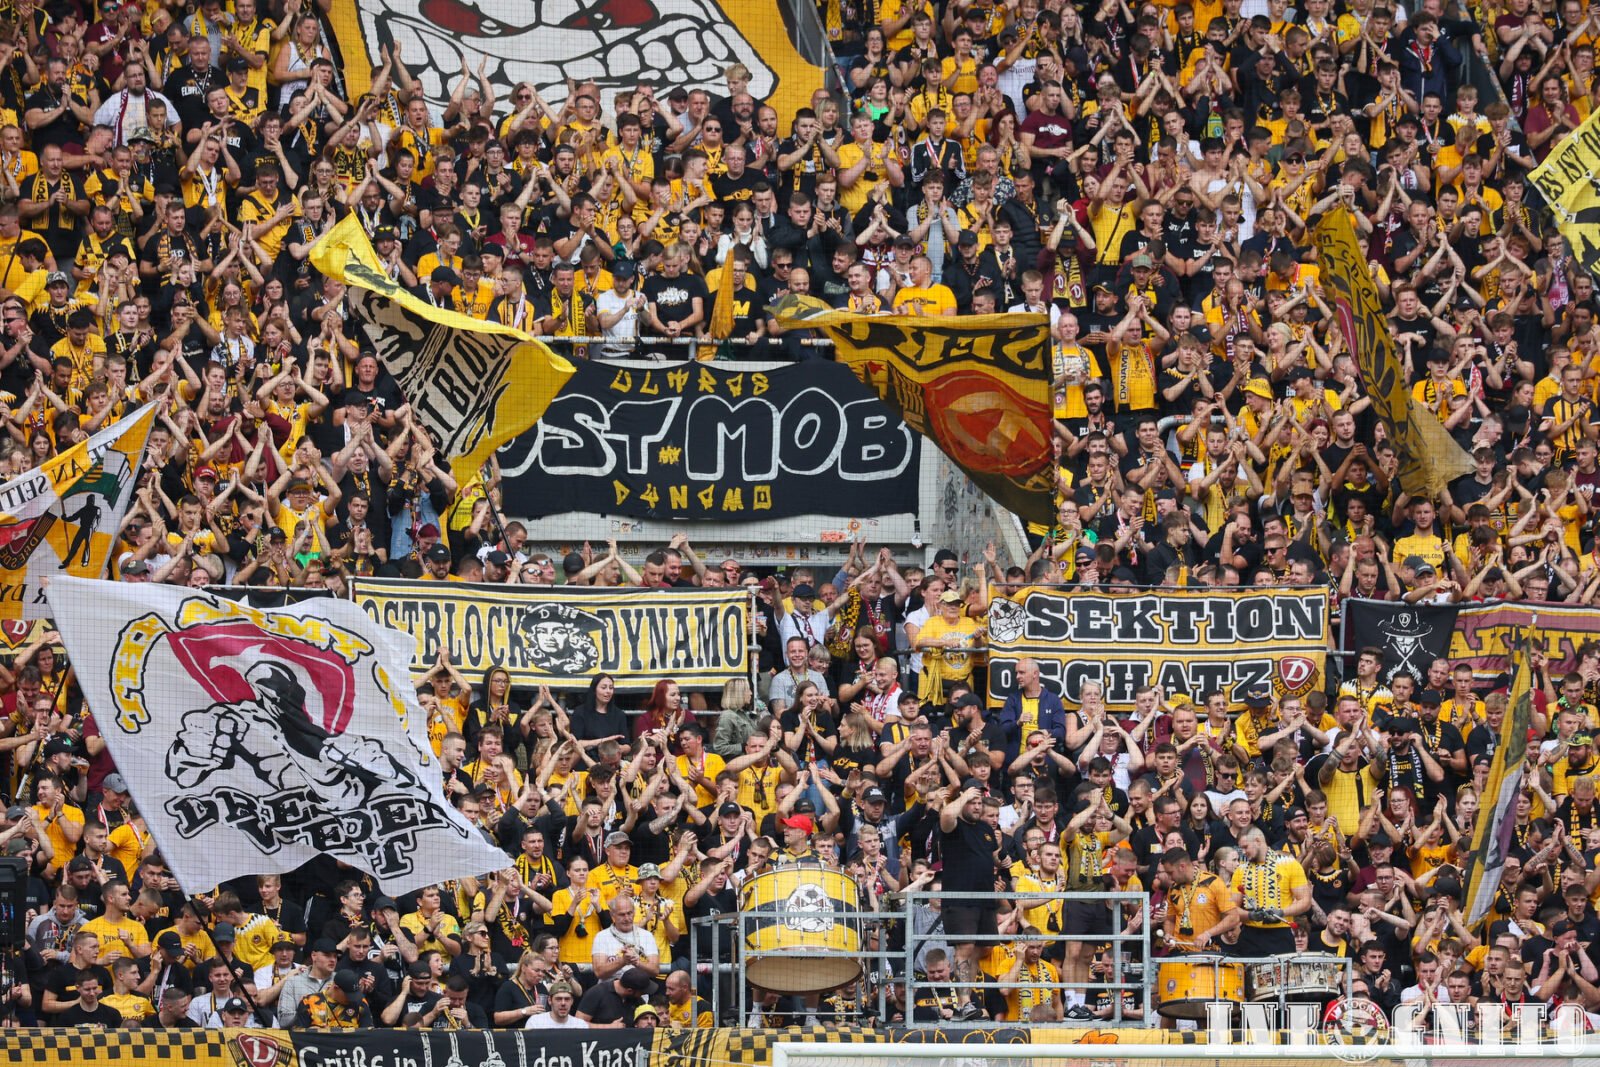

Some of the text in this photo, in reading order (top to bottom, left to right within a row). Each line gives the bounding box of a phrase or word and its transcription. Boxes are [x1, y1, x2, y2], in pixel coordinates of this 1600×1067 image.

[1535, 170, 1564, 201] ES
[1556, 142, 1589, 185] IST
[610, 369, 769, 398] ULTRAS
[1119, 348, 1130, 401] DYNAMO
[600, 604, 745, 671] DYNAMO
[1023, 593, 1325, 643] SEKTION
[989, 657, 1275, 705] OSCHATZ
[103, 934, 133, 945] DYNO
